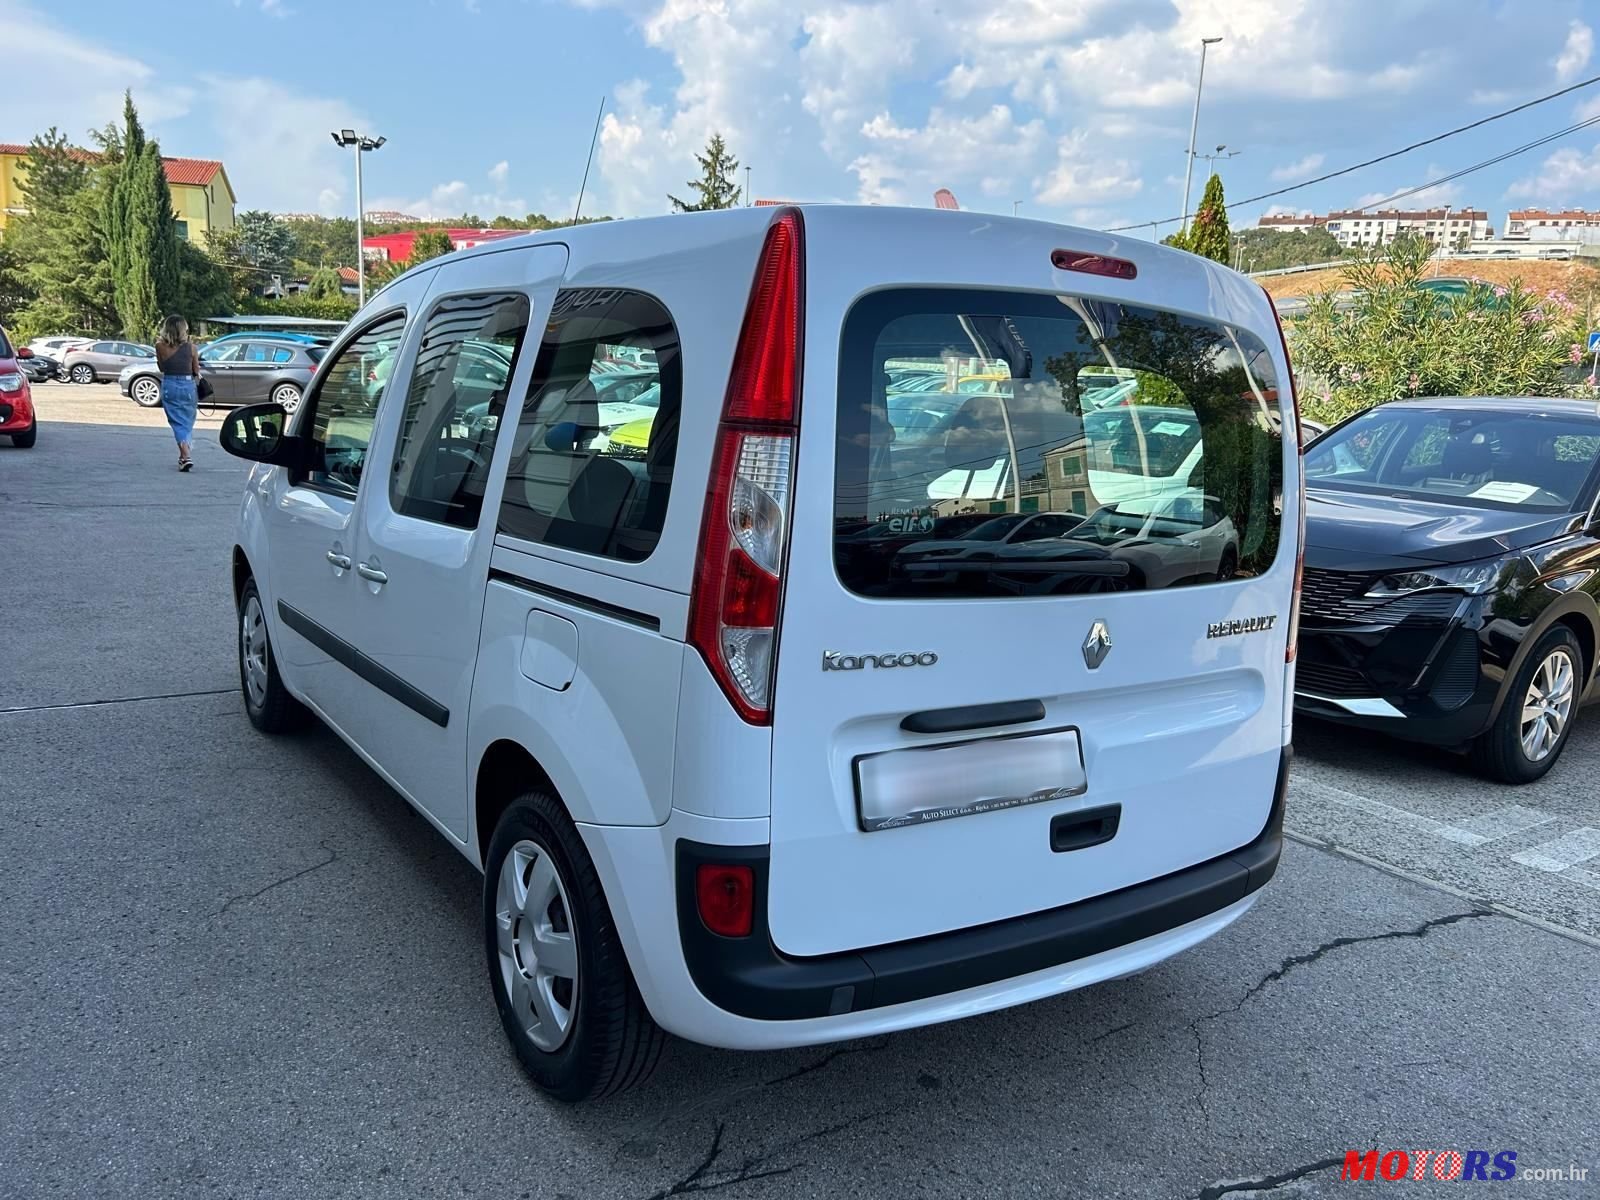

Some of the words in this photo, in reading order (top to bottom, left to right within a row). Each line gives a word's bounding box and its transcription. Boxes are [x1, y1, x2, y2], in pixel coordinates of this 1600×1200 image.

[888, 517, 919, 532] elf
[1207, 615, 1277, 639] RENAULT
[921, 812, 939, 821] AUTO
[939, 808, 959, 818] SELECT
